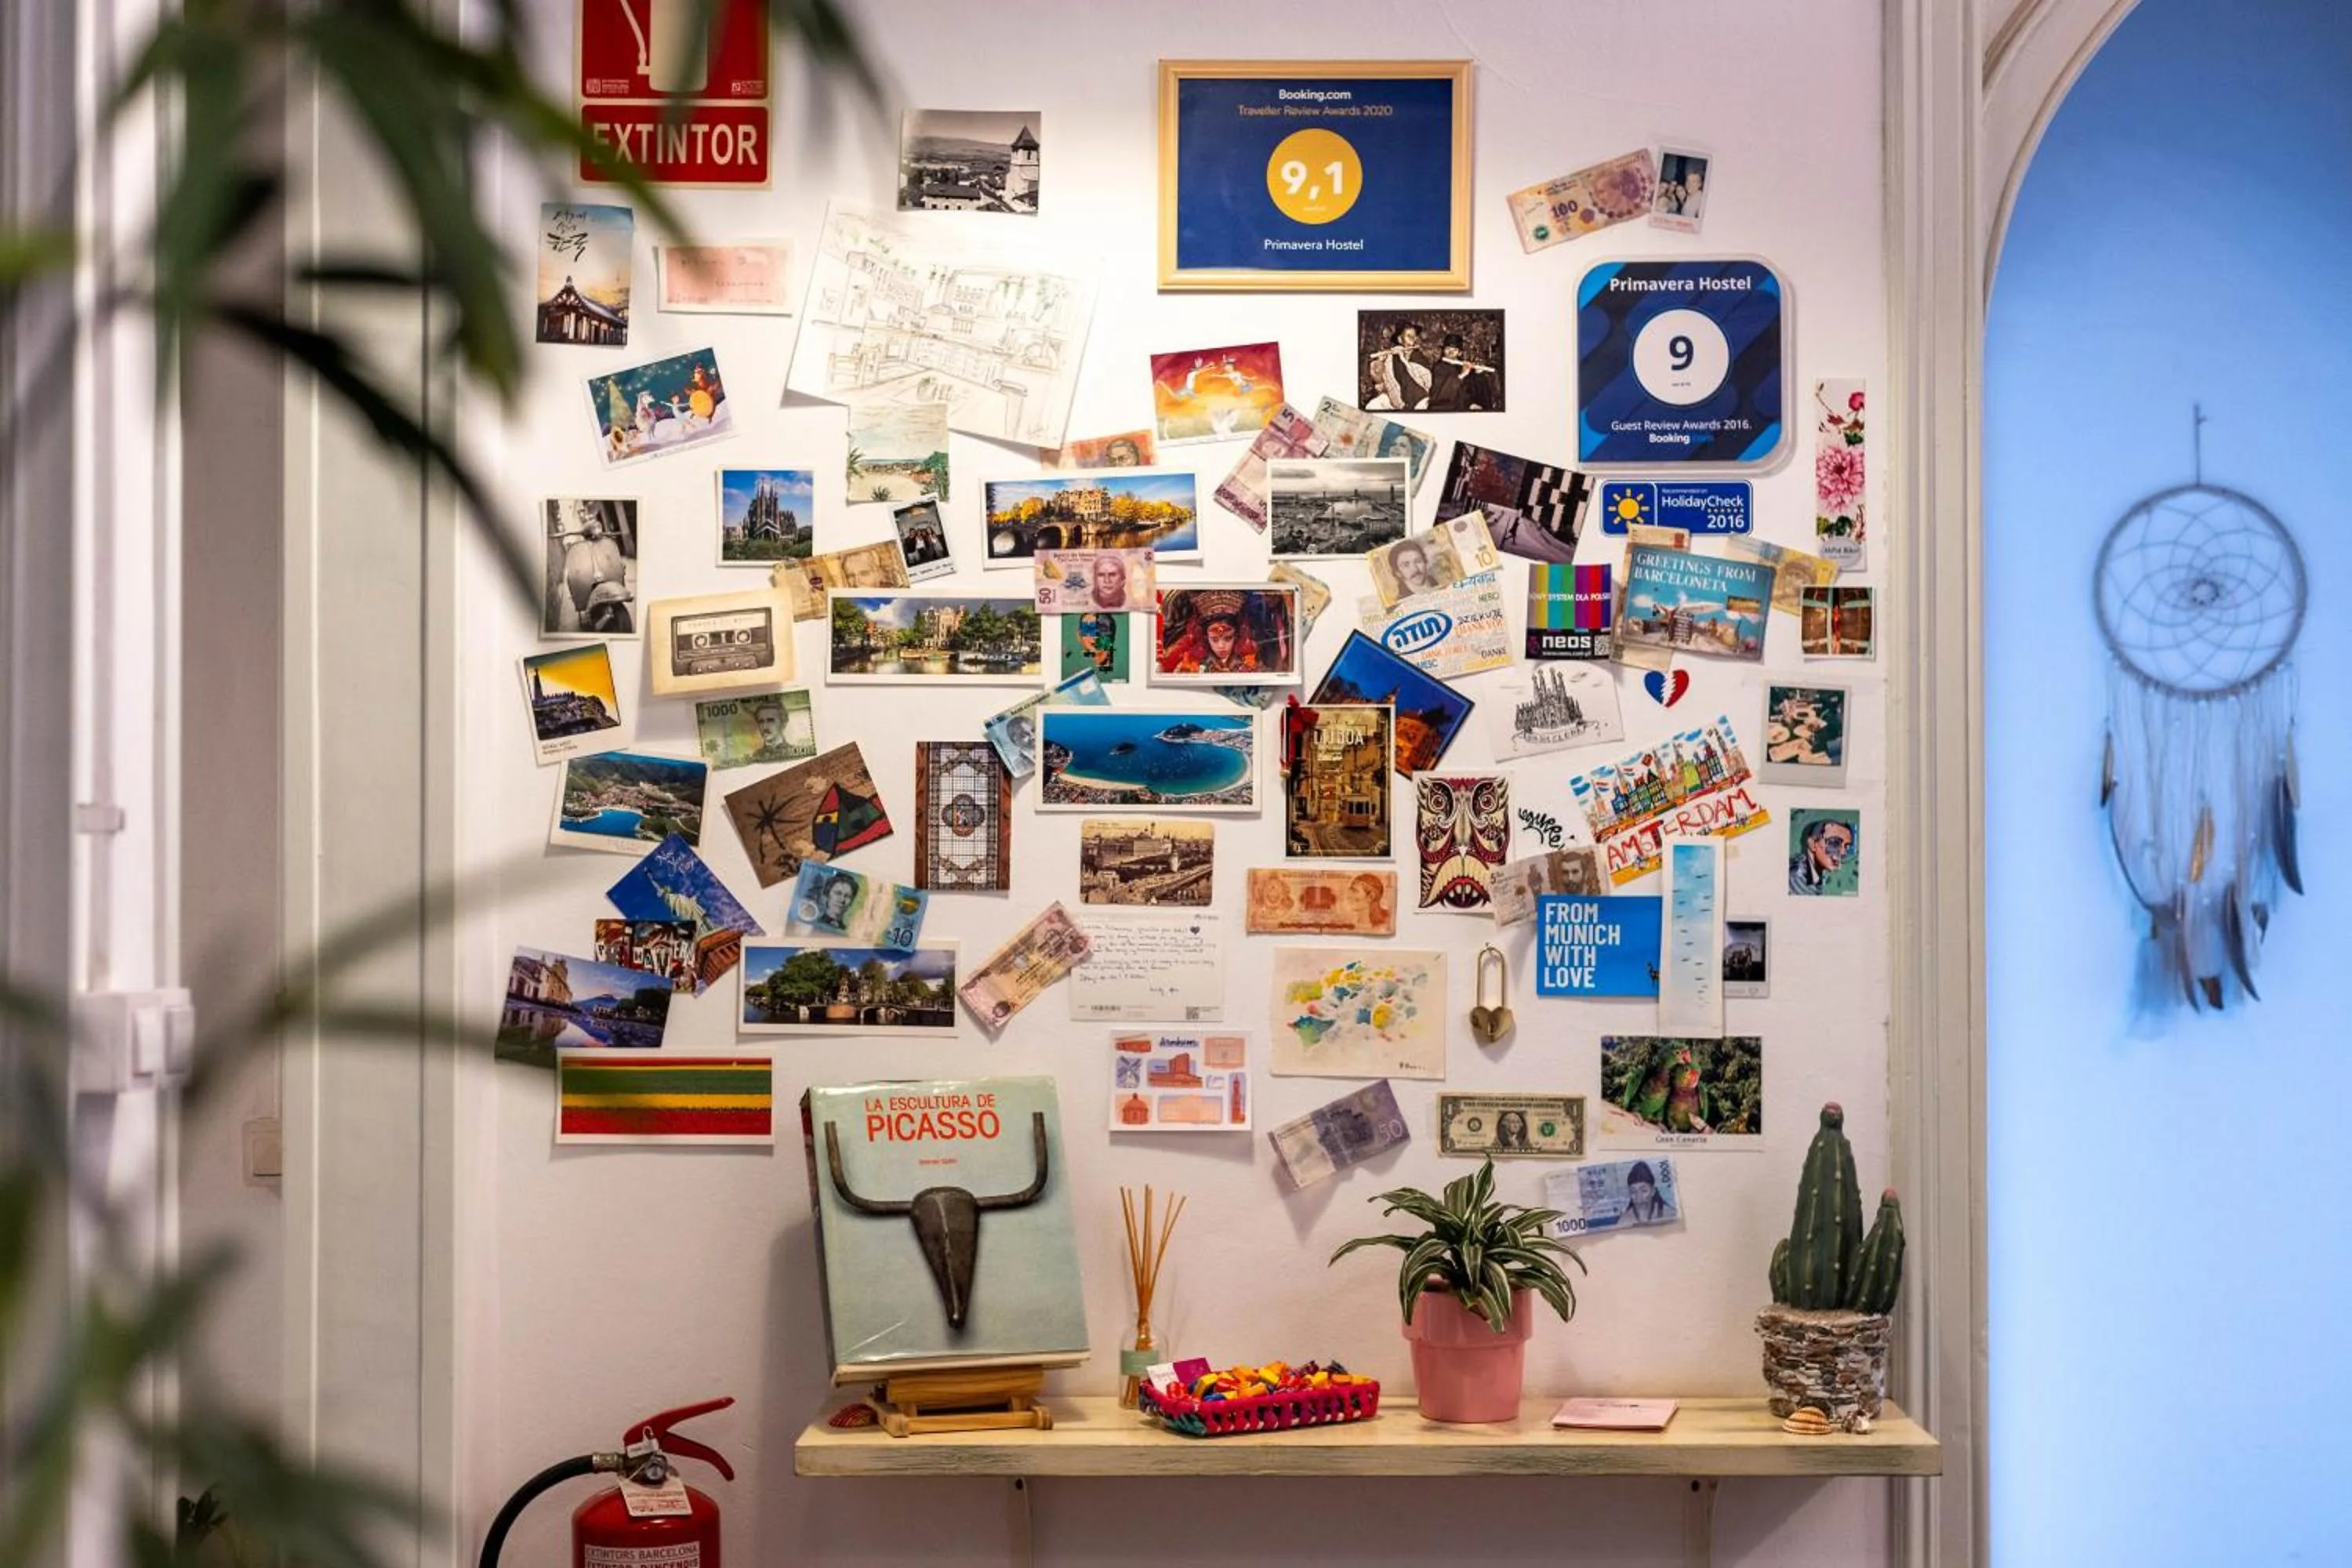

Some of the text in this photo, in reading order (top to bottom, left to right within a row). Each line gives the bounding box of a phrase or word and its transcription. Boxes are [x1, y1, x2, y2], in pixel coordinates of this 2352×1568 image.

[1279, 89, 1352, 102] Booking.com
[1239, 105, 1393, 116] Traveller Review Awards 2020
[593, 123, 759, 166] EXTINTOR
[1280, 159, 1344, 201] 9,1
[1264, 238, 1364, 251] Primavera Hostel
[1610, 275, 1752, 292] Primavera Hostel
[1668, 335, 1695, 372] 9
[1611, 420, 1642, 431] Guest
[1644, 419, 1680, 430] Review
[1682, 419, 1721, 430] Awards
[1661, 494, 1744, 512] HolidayCheck
[1707, 514, 1745, 529] 2016
[1635, 551, 1757, 583] GREETINGS FROM
[1633, 567, 1728, 593] BARCELONETA
[1542, 635, 1592, 649] neos
[706, 702, 738, 718] 1000
[1545, 902, 1599, 924] FROM
[893, 927, 913, 948] 10
[1544, 924, 1621, 945] MUNICH
[1544, 946, 1596, 966] WITH
[1544, 967, 1596, 989] LOVE
[865, 1093, 996, 1112] LA ESCULTURA DE
[866, 1110, 1000, 1142] PICASSO
[1379, 1119, 1403, 1142] 50
[1555, 1218, 1587, 1233] 1000
[639, 1545, 699, 1560] BARCELONA
